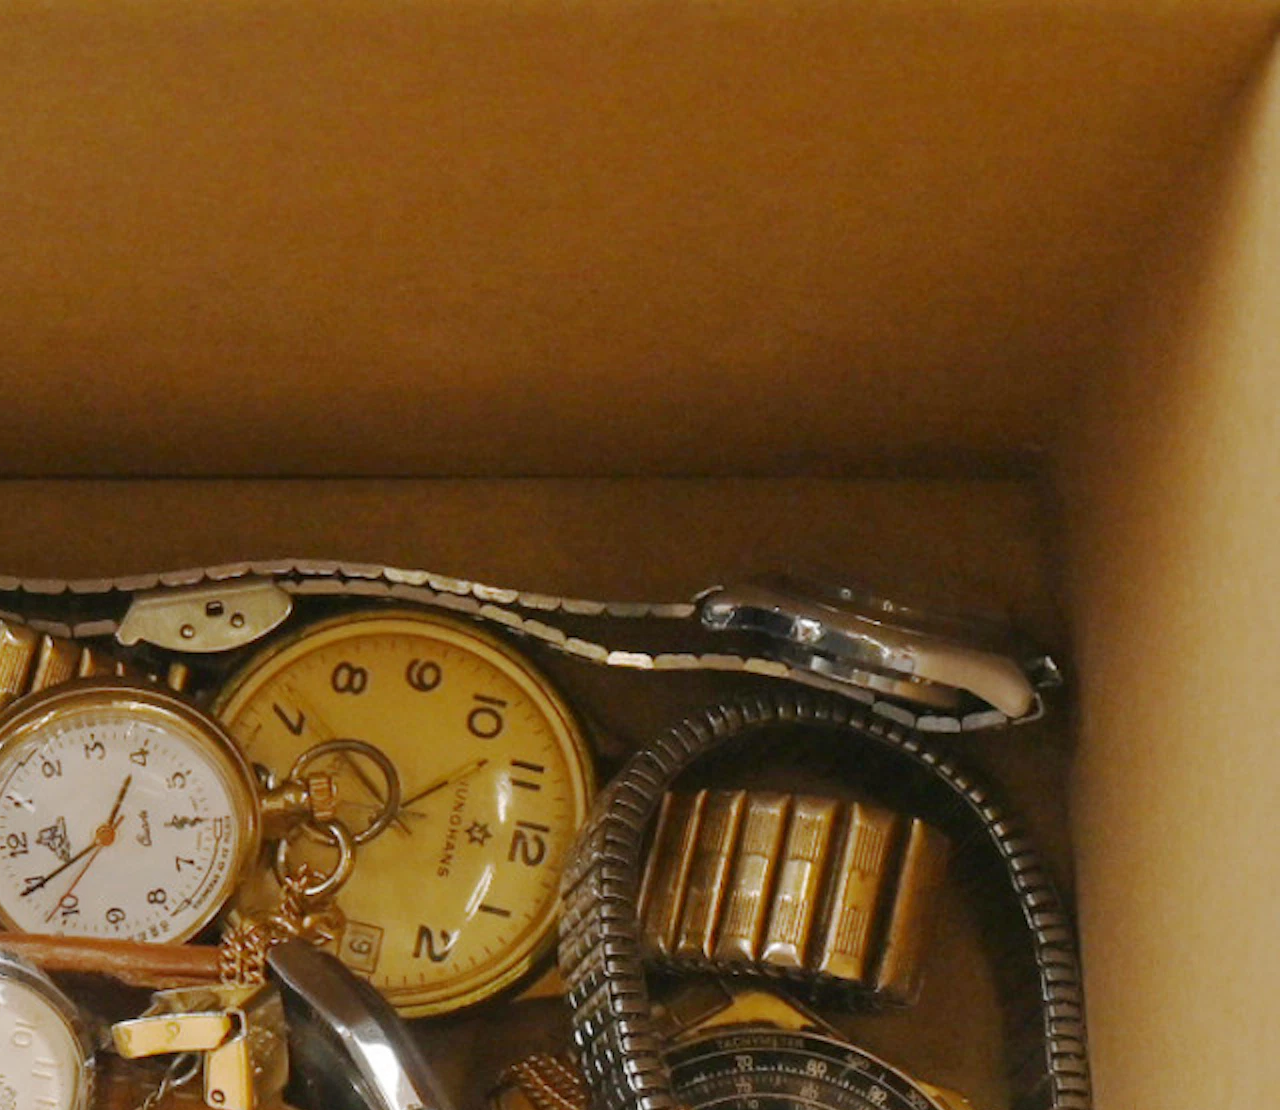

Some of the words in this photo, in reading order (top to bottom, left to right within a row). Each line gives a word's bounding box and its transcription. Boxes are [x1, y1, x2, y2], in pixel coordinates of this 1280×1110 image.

[331, 661, 367, 694] 8
[406, 658, 442, 692] 9
[273, 702, 306, 736] 7
[467, 693, 508, 739] 10
[84, 739, 106, 760] 3
[41, 758, 62, 778] 2
[510, 758, 545, 791] 11
[6, 831, 29, 858] 12
[436, 780, 469, 878] JUNGHANS
[508, 820, 550, 867] 12
[175, 855, 196, 873] 7
[147, 887, 168, 905] 8
[413, 924, 453, 963] 2
